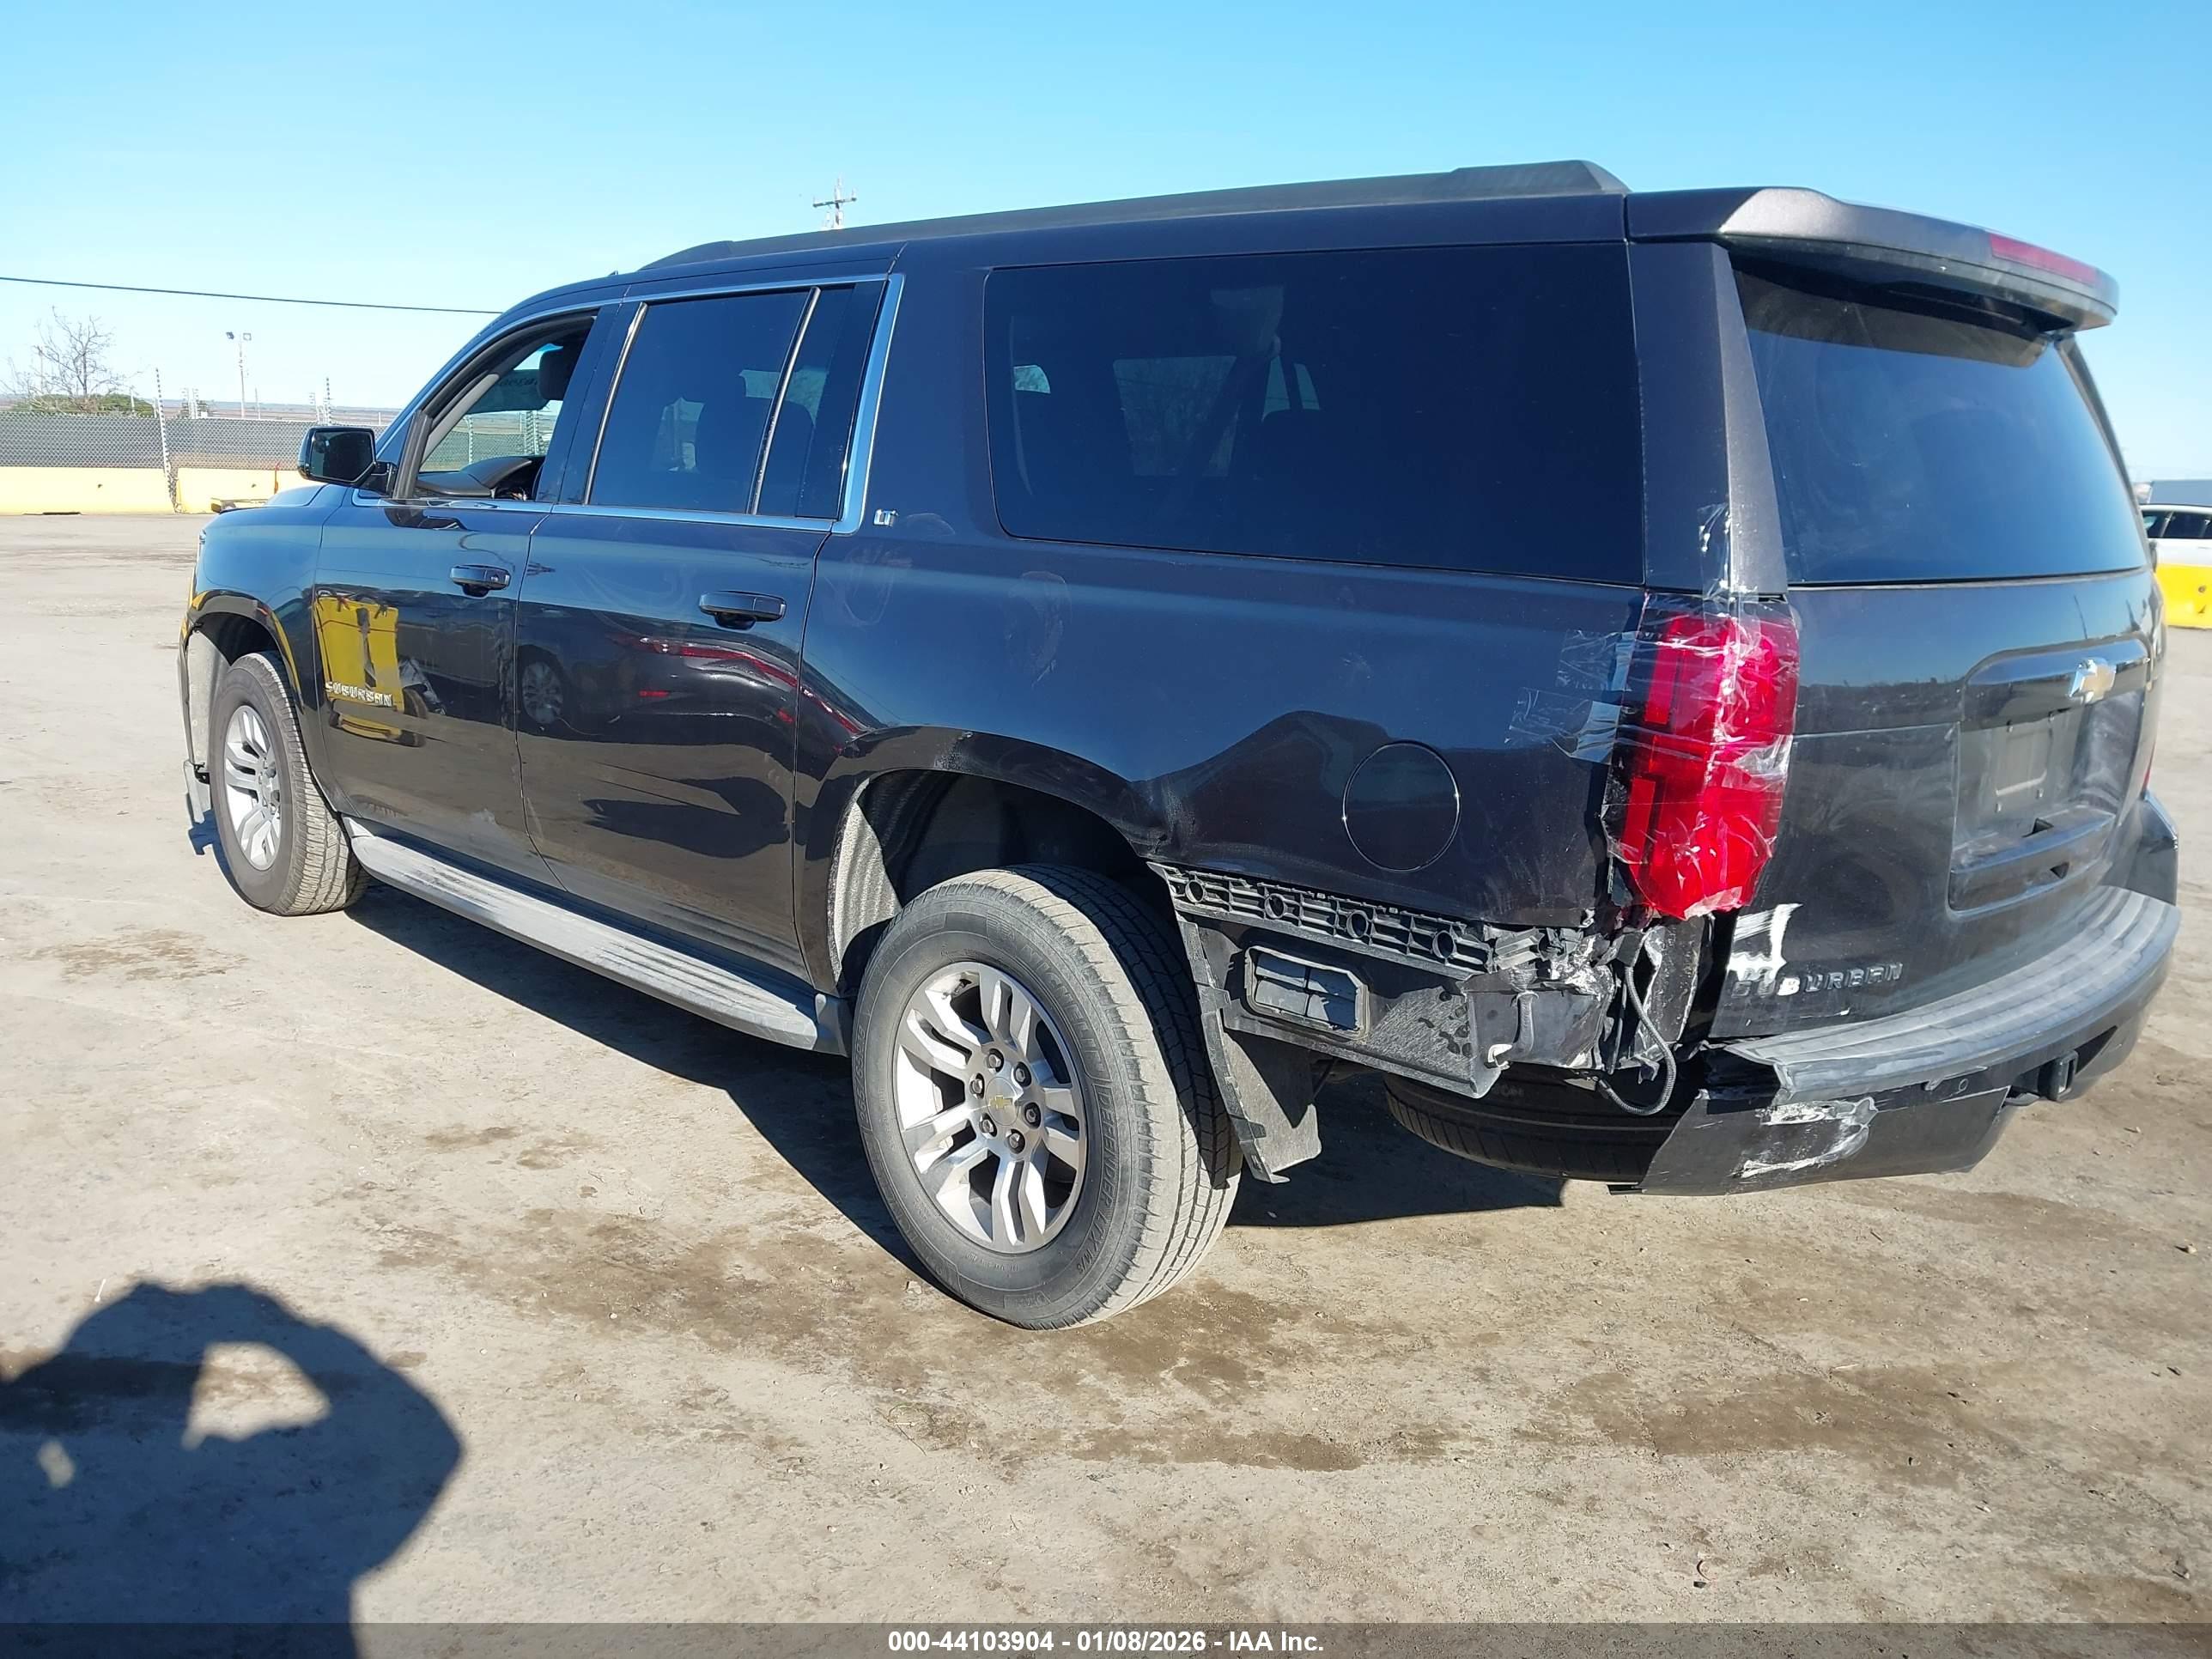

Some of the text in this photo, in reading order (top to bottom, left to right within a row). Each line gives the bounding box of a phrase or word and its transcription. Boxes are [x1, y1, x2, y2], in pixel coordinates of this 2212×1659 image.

[873, 508, 896, 526] LT
[325, 680, 392, 708] SUBURBAN
[1730, 963, 1904, 998] SUBURBAN
[1019, 944, 1105, 1072] MICHELIN
